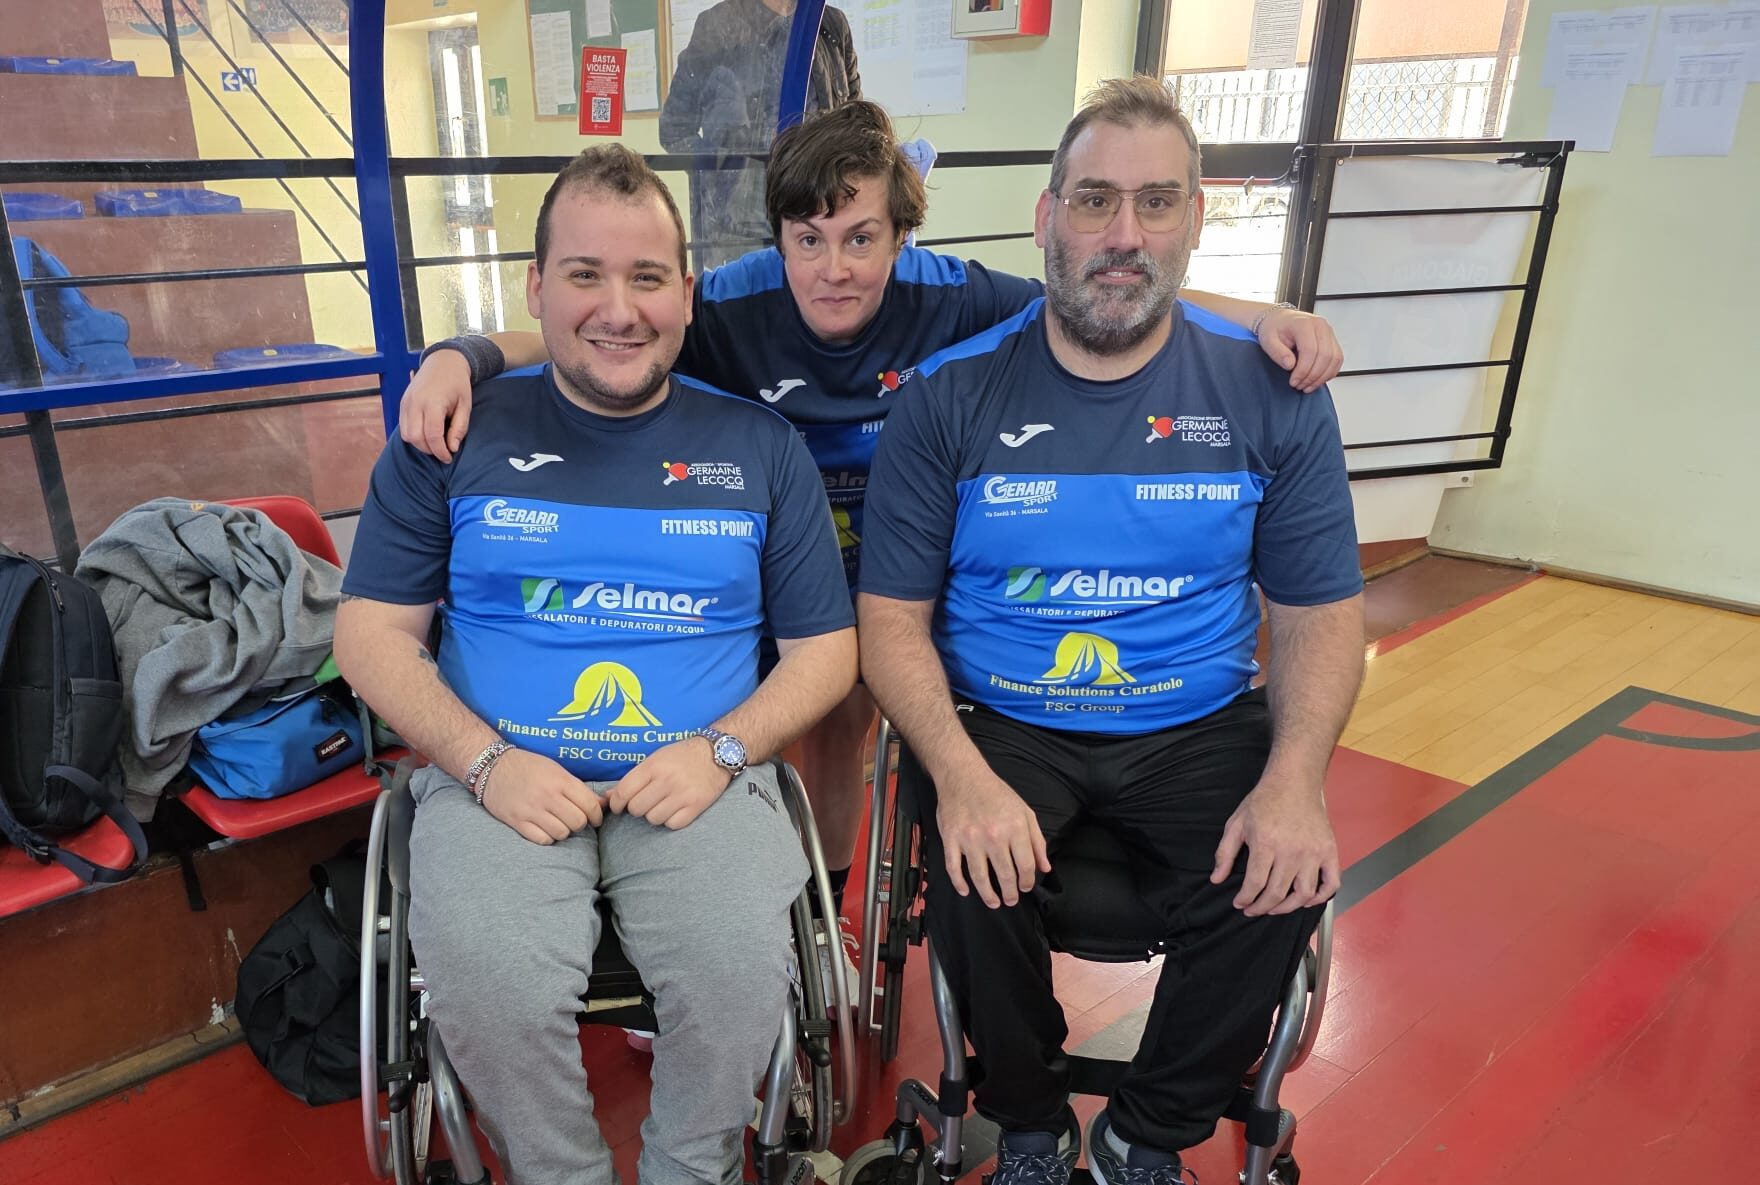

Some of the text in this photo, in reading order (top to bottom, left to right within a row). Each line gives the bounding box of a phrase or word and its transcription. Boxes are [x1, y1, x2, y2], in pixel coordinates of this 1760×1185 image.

[592, 54, 616, 64] BASTA
[586, 63, 620, 73] VIOLENZA
[1172, 419, 1229, 431] GERMAINE
[1182, 431, 1231, 442] LECOCQ
[687, 467, 742, 476] GERMAINE
[697, 476, 744, 485] LECOCQ
[984, 476, 1057, 500] GERARD
[1023, 492, 1058, 507] SPORT
[1136, 484, 1241, 500] FITNESS POINT
[484, 499, 559, 526] GERARD
[522, 525, 560, 534] SPORT
[661, 519, 754, 537] FITNESS POINT
[520, 535, 548, 543] MARSALA
[528, 613, 588, 625] SSALATORI
[590, 617, 597, 625] E
[600, 618, 664, 632] DEPURATORI
[990, 674, 1184, 697] Finance Solutions Curatolo
[1044, 701, 1125, 714] FSC Group
[498, 718, 558, 738] Finance
[562, 727, 638, 743] Solutions
[320, 736, 347, 755] EASTPAK
[559, 746, 647, 764] FSC Group
